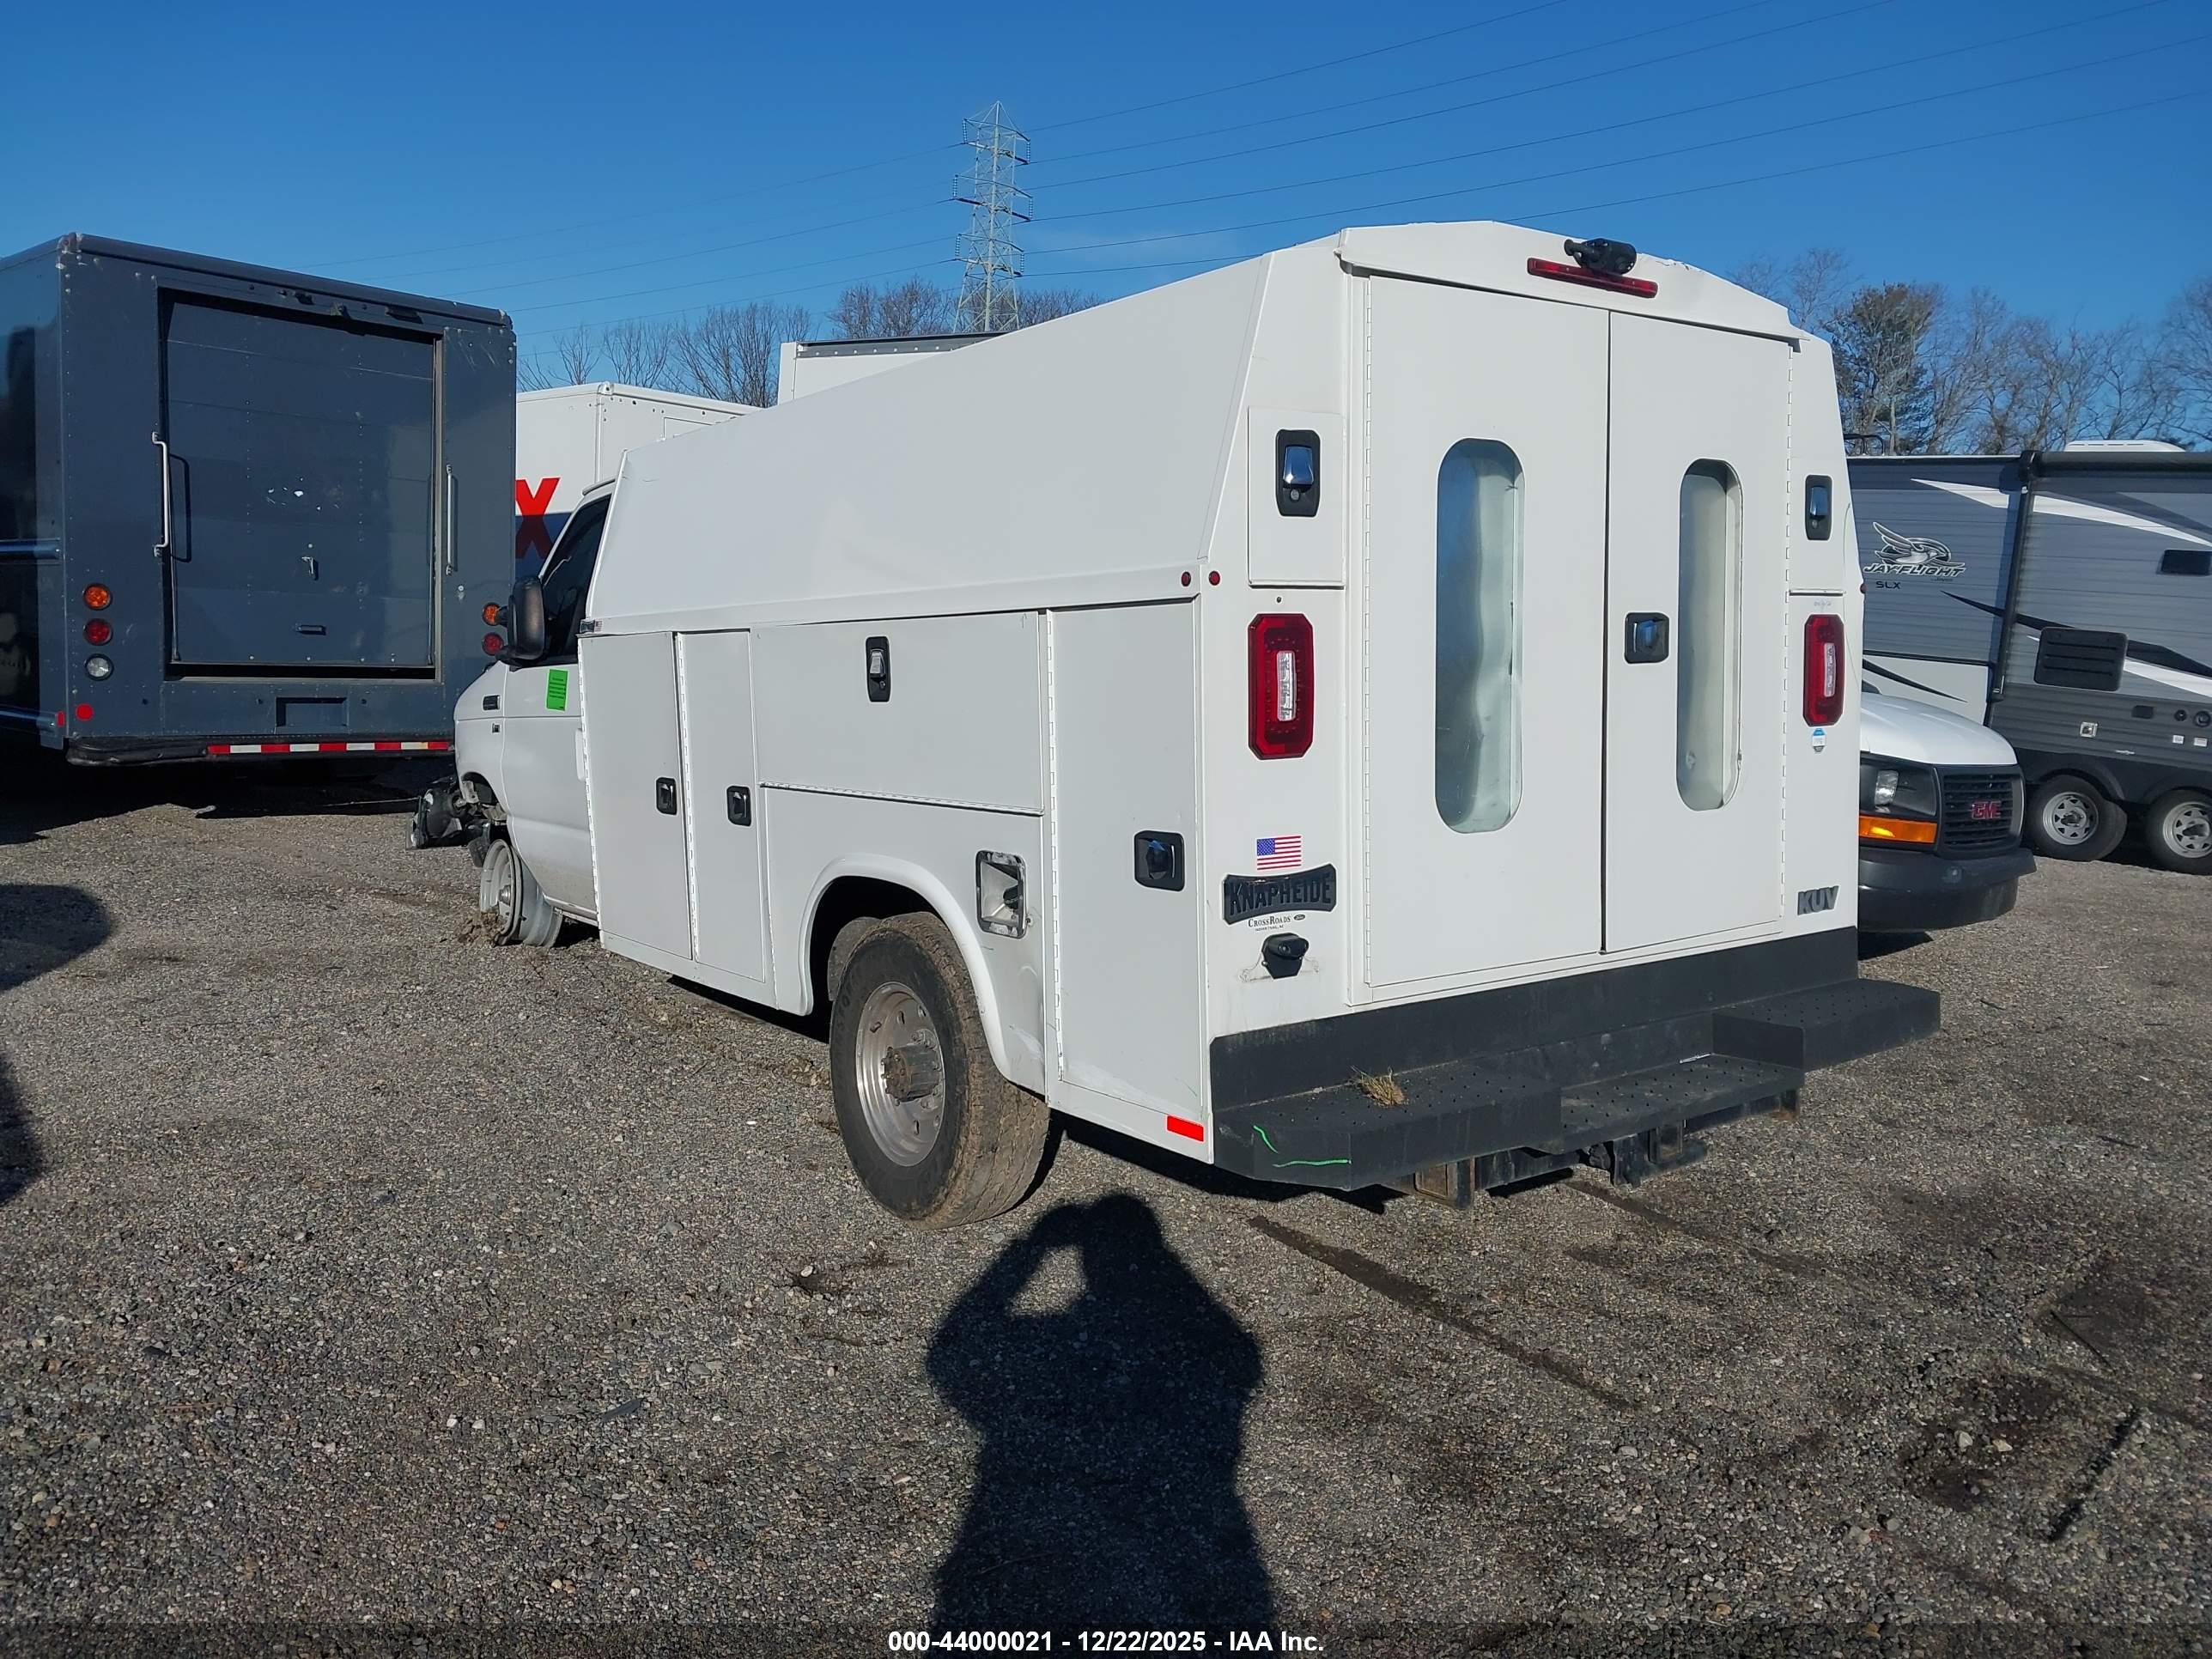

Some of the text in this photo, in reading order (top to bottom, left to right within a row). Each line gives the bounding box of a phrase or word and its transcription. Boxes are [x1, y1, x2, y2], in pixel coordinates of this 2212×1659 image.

[1875, 580, 1901, 590] SLX
[1971, 800, 2002, 820] GMC
[1228, 872, 1332, 916] KNAPHEIDE
[1797, 885, 1839, 916] KUV
